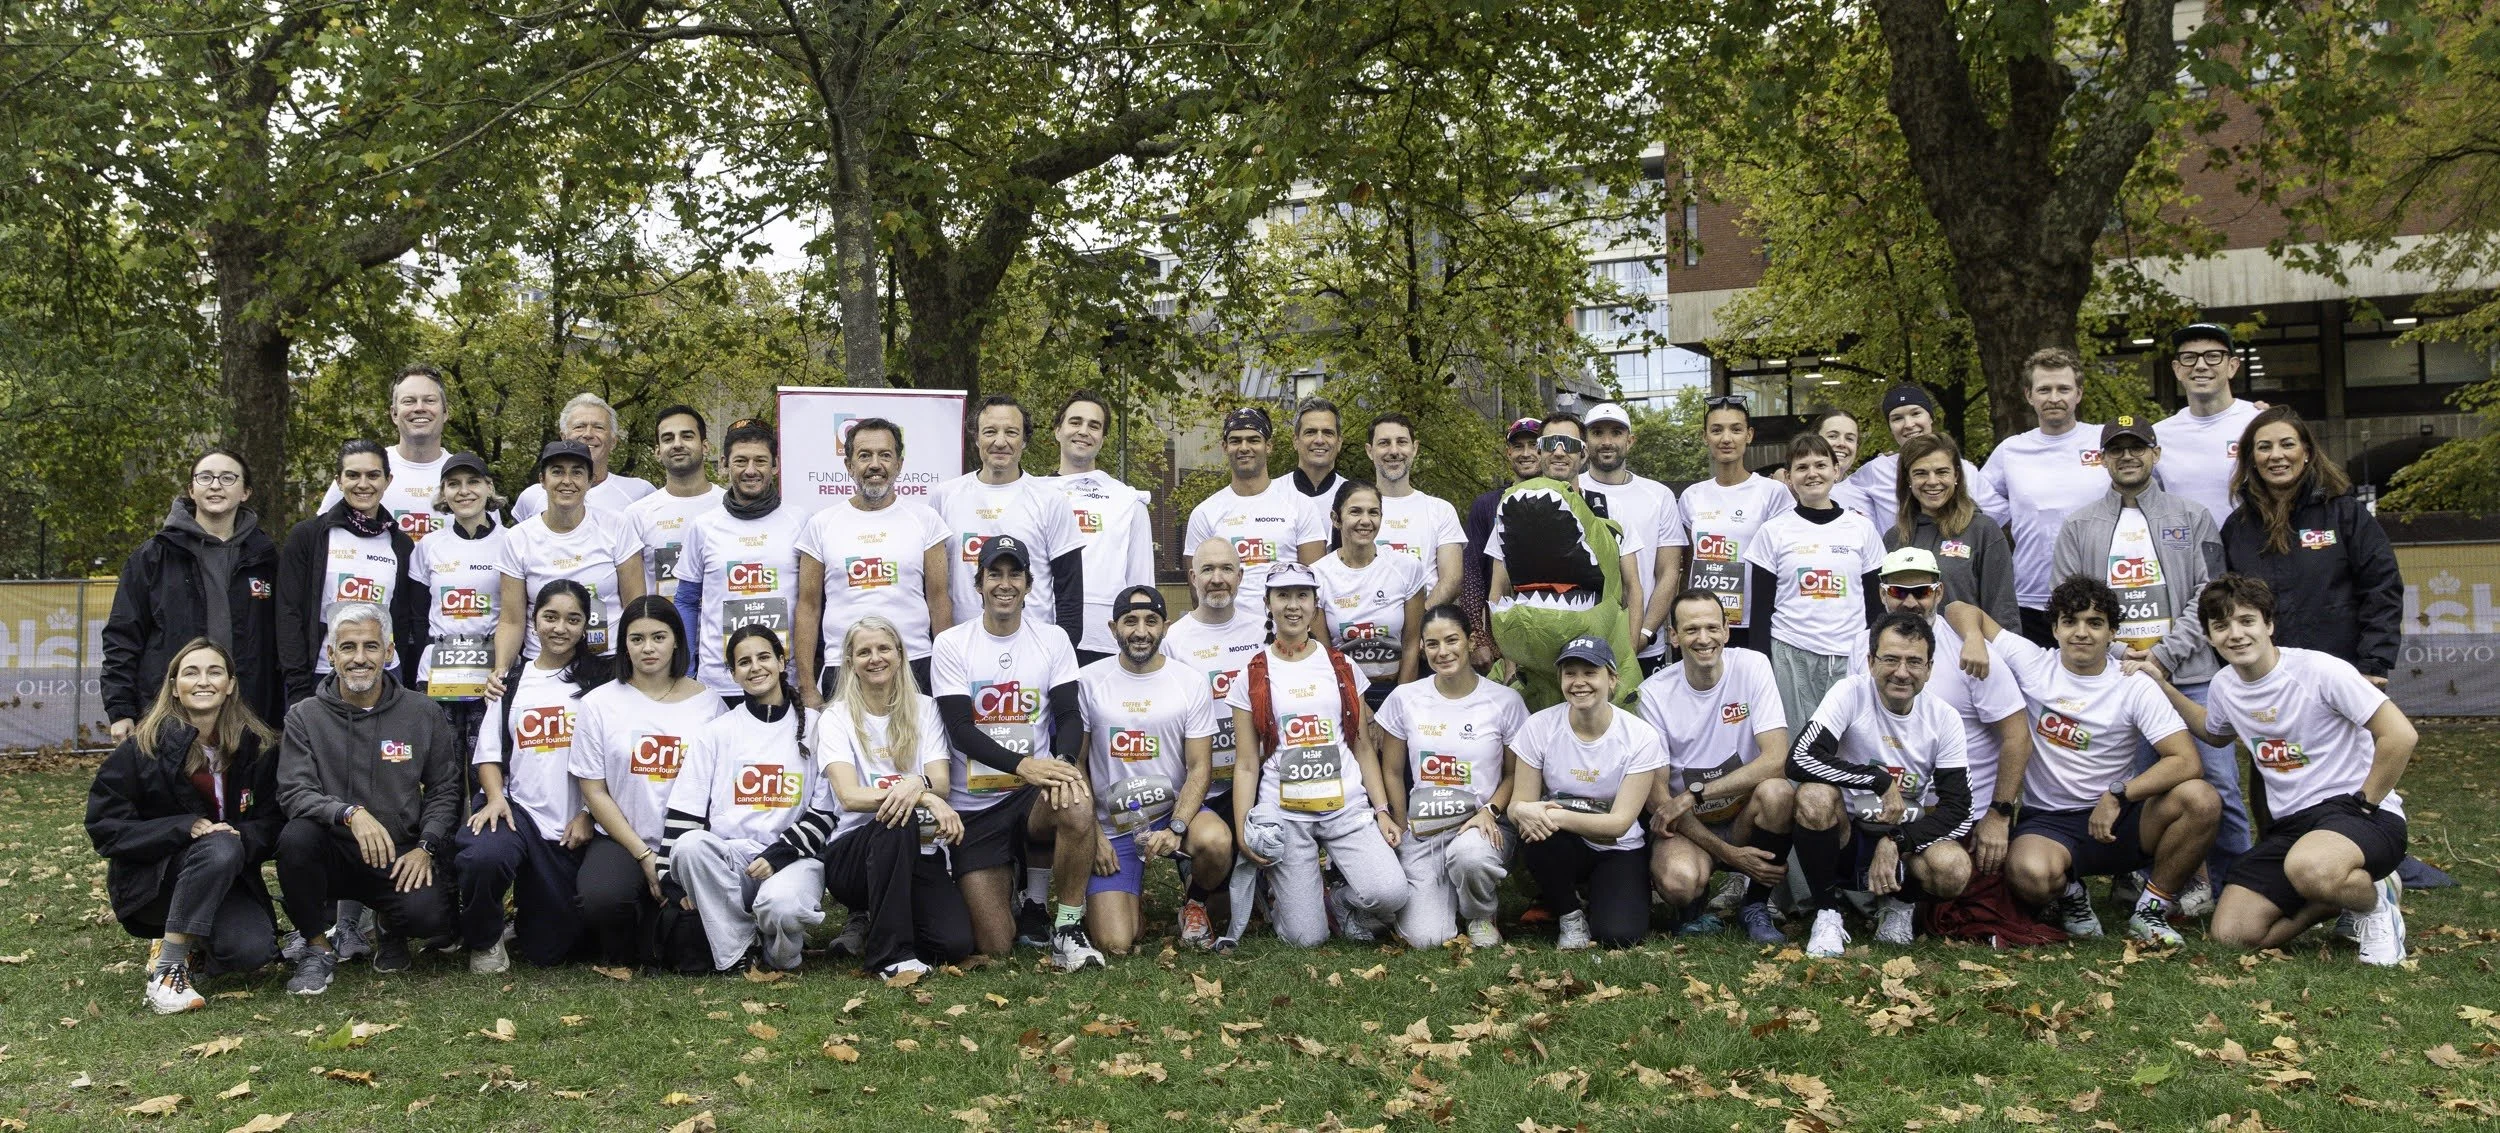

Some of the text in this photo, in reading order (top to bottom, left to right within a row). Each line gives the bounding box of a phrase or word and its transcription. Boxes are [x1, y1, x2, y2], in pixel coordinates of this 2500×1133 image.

[894, 472, 940, 483] EARCH
[894, 485, 927, 496] HOPE
[399, 513, 441, 531] Cris
[1074, 510, 1100, 526] ris
[1697, 535, 1737, 555] Cris
[2301, 530, 2333, 543] Cris
[1235, 539, 1276, 558] Cris
[366, 554, 396, 566] MOODY'S
[848, 558, 897, 579] Cris
[2111, 559, 2155, 579] Cris
[730, 563, 777, 584] Cris
[1800, 570, 1845, 591] Cris
[340, 577, 384, 600] Cris
[1693, 575, 1740, 591] 26957
[442, 589, 489, 609] Cris
[1343, 623, 1388, 641] Cris
[1229, 643, 1260, 653] MOODY'S
[437, 650, 489, 666] 15223
[974, 683, 1040, 717] Cris
[1721, 703, 1749, 719] Cris
[517, 708, 576, 738] Cris
[1285, 715, 1331, 738] Cris
[2040, 710, 2087, 744] Cris
[383, 742, 413, 756] Cris
[520, 738, 544, 746] cancer
[1111, 732, 1158, 752] Cris
[2256, 740, 2301, 762] Cris
[633, 765, 657, 773] cancer
[1288, 762, 1335, 780] 3020
[1421, 755, 1469, 777] Cris
[736, 765, 800, 796] Cris
[1418, 800, 1467, 817] 21153
